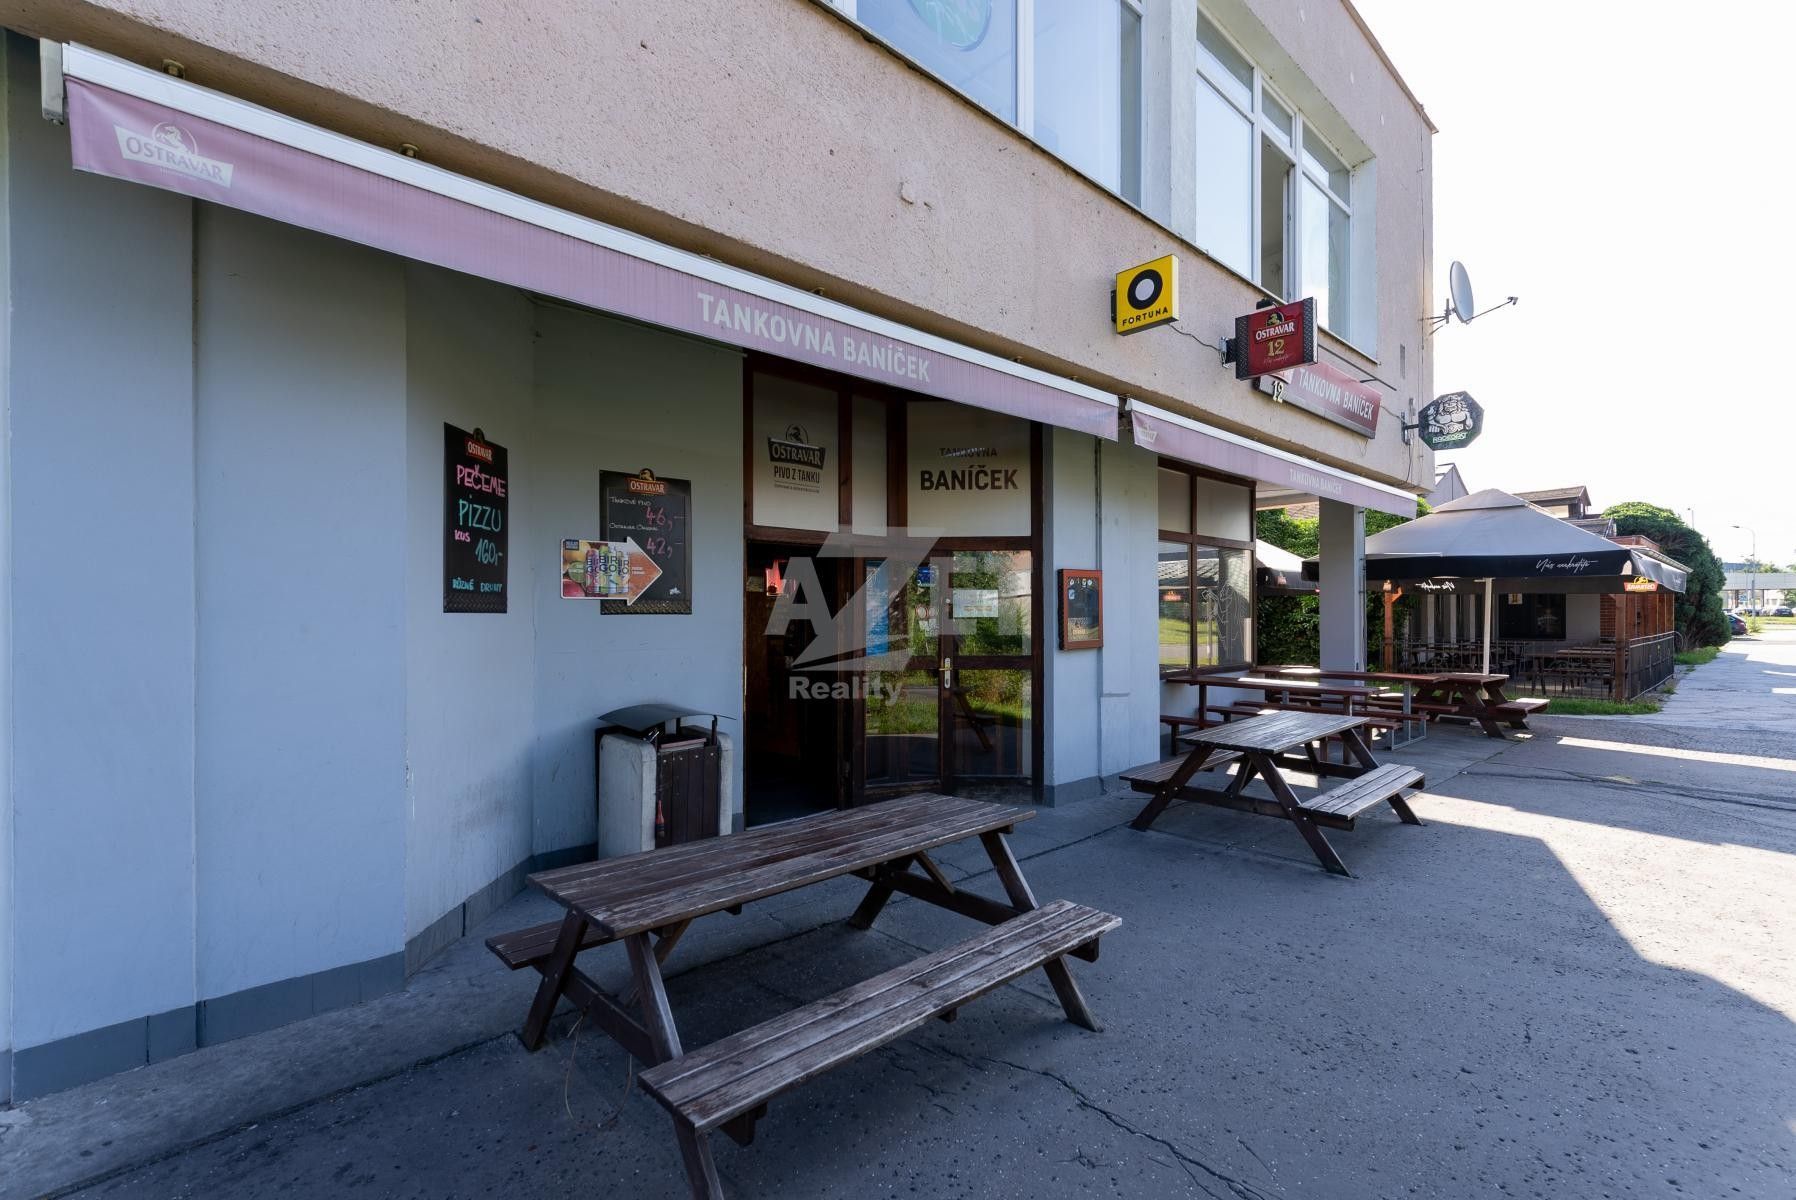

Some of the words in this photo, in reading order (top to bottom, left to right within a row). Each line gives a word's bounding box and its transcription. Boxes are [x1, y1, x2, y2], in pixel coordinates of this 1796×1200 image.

[126, 136, 225, 182] OSTRAVAR
[1122, 306, 1169, 327] FORTUNA
[697, 292, 836, 358] TANKOVNA
[843, 336, 931, 383] BANÍČEK
[1255, 321, 1295, 341] OSTRAVAR
[1267, 338, 1285, 357] 12
[1272, 380, 1284, 404] 12
[1300, 367, 1342, 406] TANKOVNA
[1342, 393, 1375, 421] BANÍČEK
[771, 443, 822, 466] OSTRAVAR
[940, 447, 998, 458] TANKOVNA
[456, 464, 506, 498] PEČEME
[773, 466, 791, 479] PIVO
[791, 468, 797, 480] Z
[797, 469, 820, 484] TANKU
[920, 464, 1018, 491] BANÍČEK
[630, 480, 665, 494] OSTRAVAR
[459, 494, 502, 533] PIZZU
[454, 530, 470, 543] KUS
